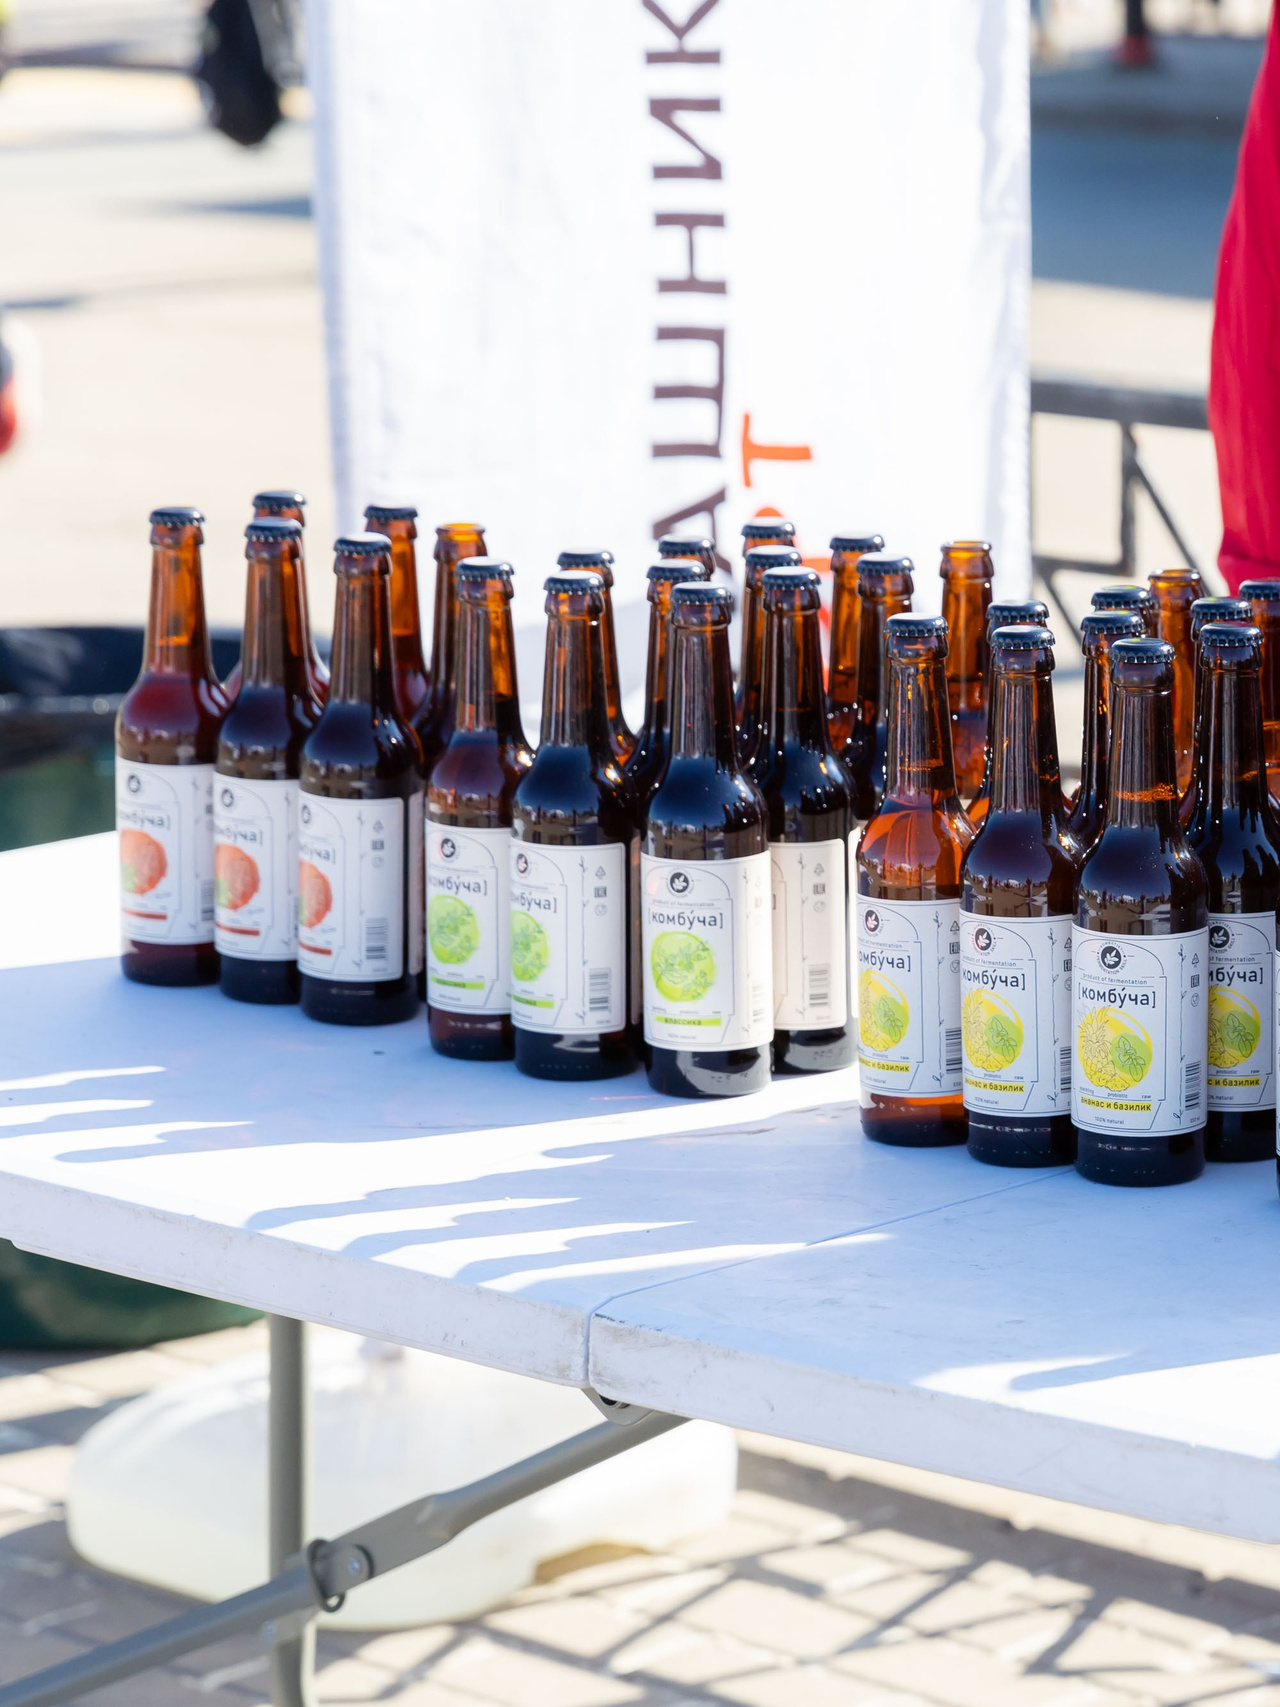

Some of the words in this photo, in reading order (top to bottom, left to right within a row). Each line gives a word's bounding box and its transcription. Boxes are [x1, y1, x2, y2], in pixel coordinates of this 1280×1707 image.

[981, 959, 1017, 967] fermentation
[1083, 973, 1099, 981] product
[1108, 977, 1147, 985] fermentation
[877, 1062, 910, 1072] базилик
[989, 1081, 1024, 1092] базилик
[1222, 1078, 1260, 1087] базилик
[1081, 1096, 1105, 1108] ананас
[1113, 1102, 1151, 1112] базилик
